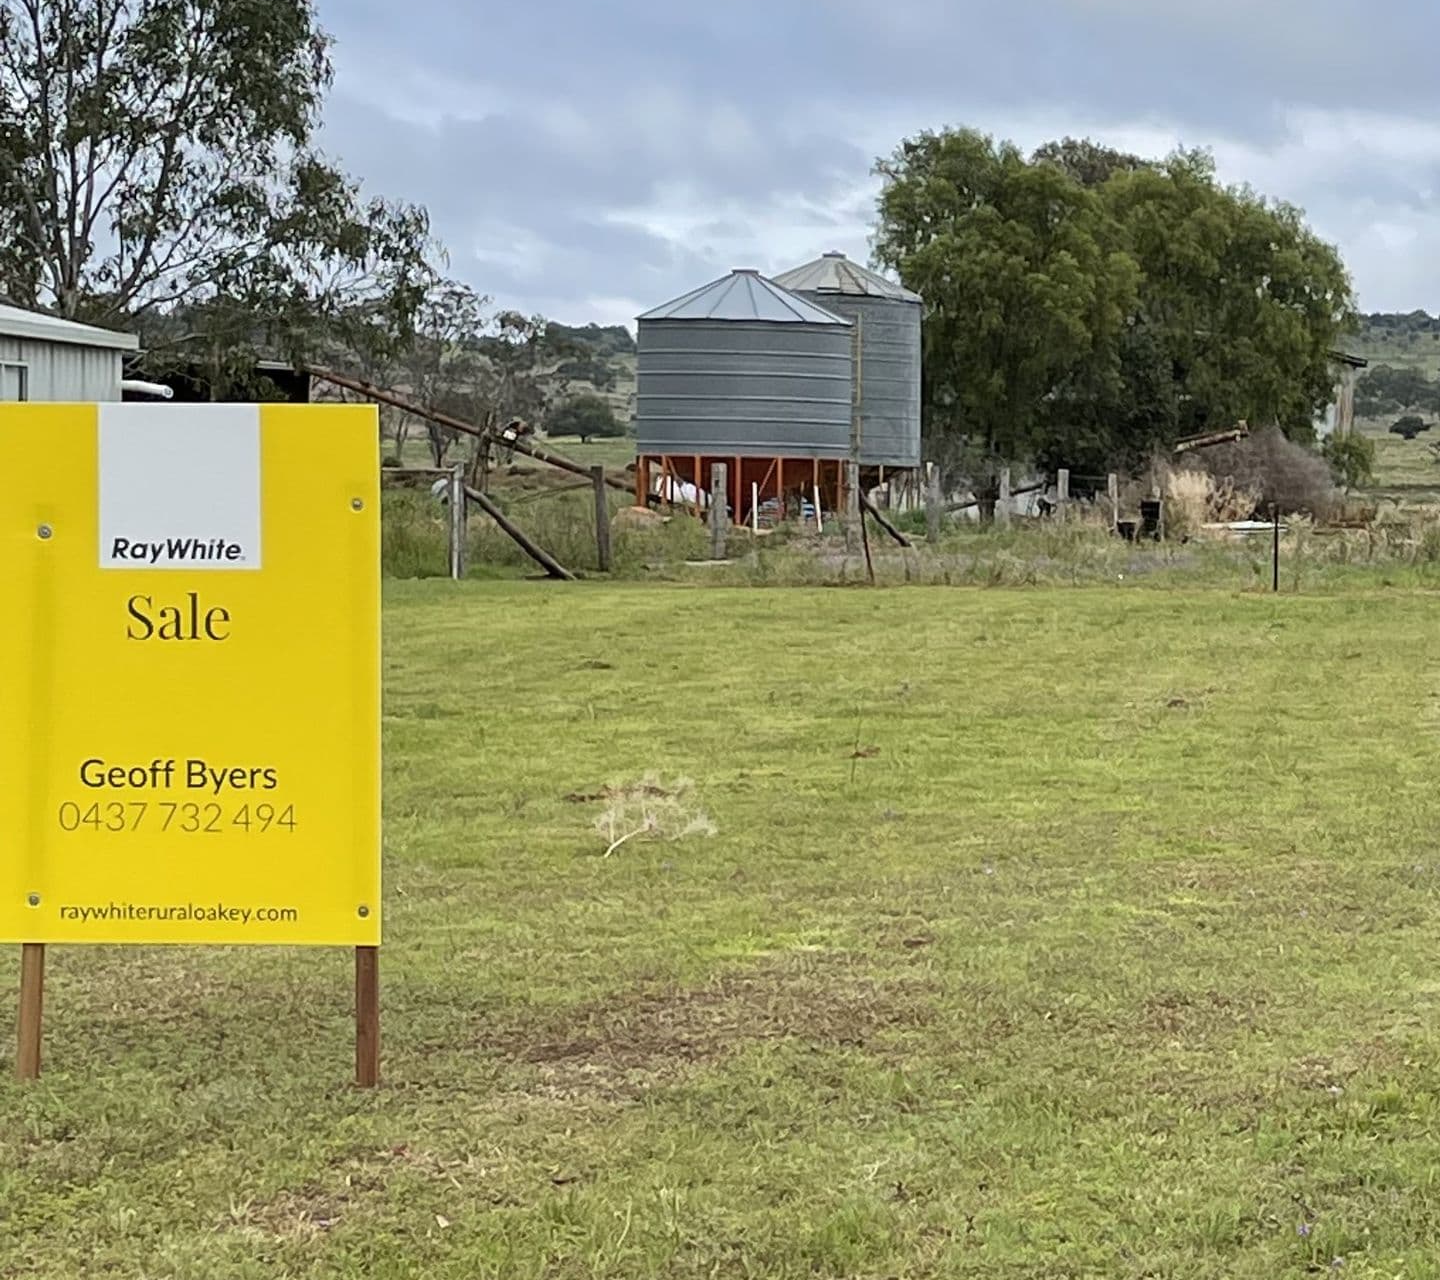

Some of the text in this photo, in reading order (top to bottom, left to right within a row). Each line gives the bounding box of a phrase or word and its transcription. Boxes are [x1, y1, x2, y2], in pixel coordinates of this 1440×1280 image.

[127, 592, 231, 641] Sale
[80, 759, 278, 795] Geoff Byers
[59, 801, 298, 833] 0437 732 494
[60, 901, 298, 926] raywhiteruraloakey.com
